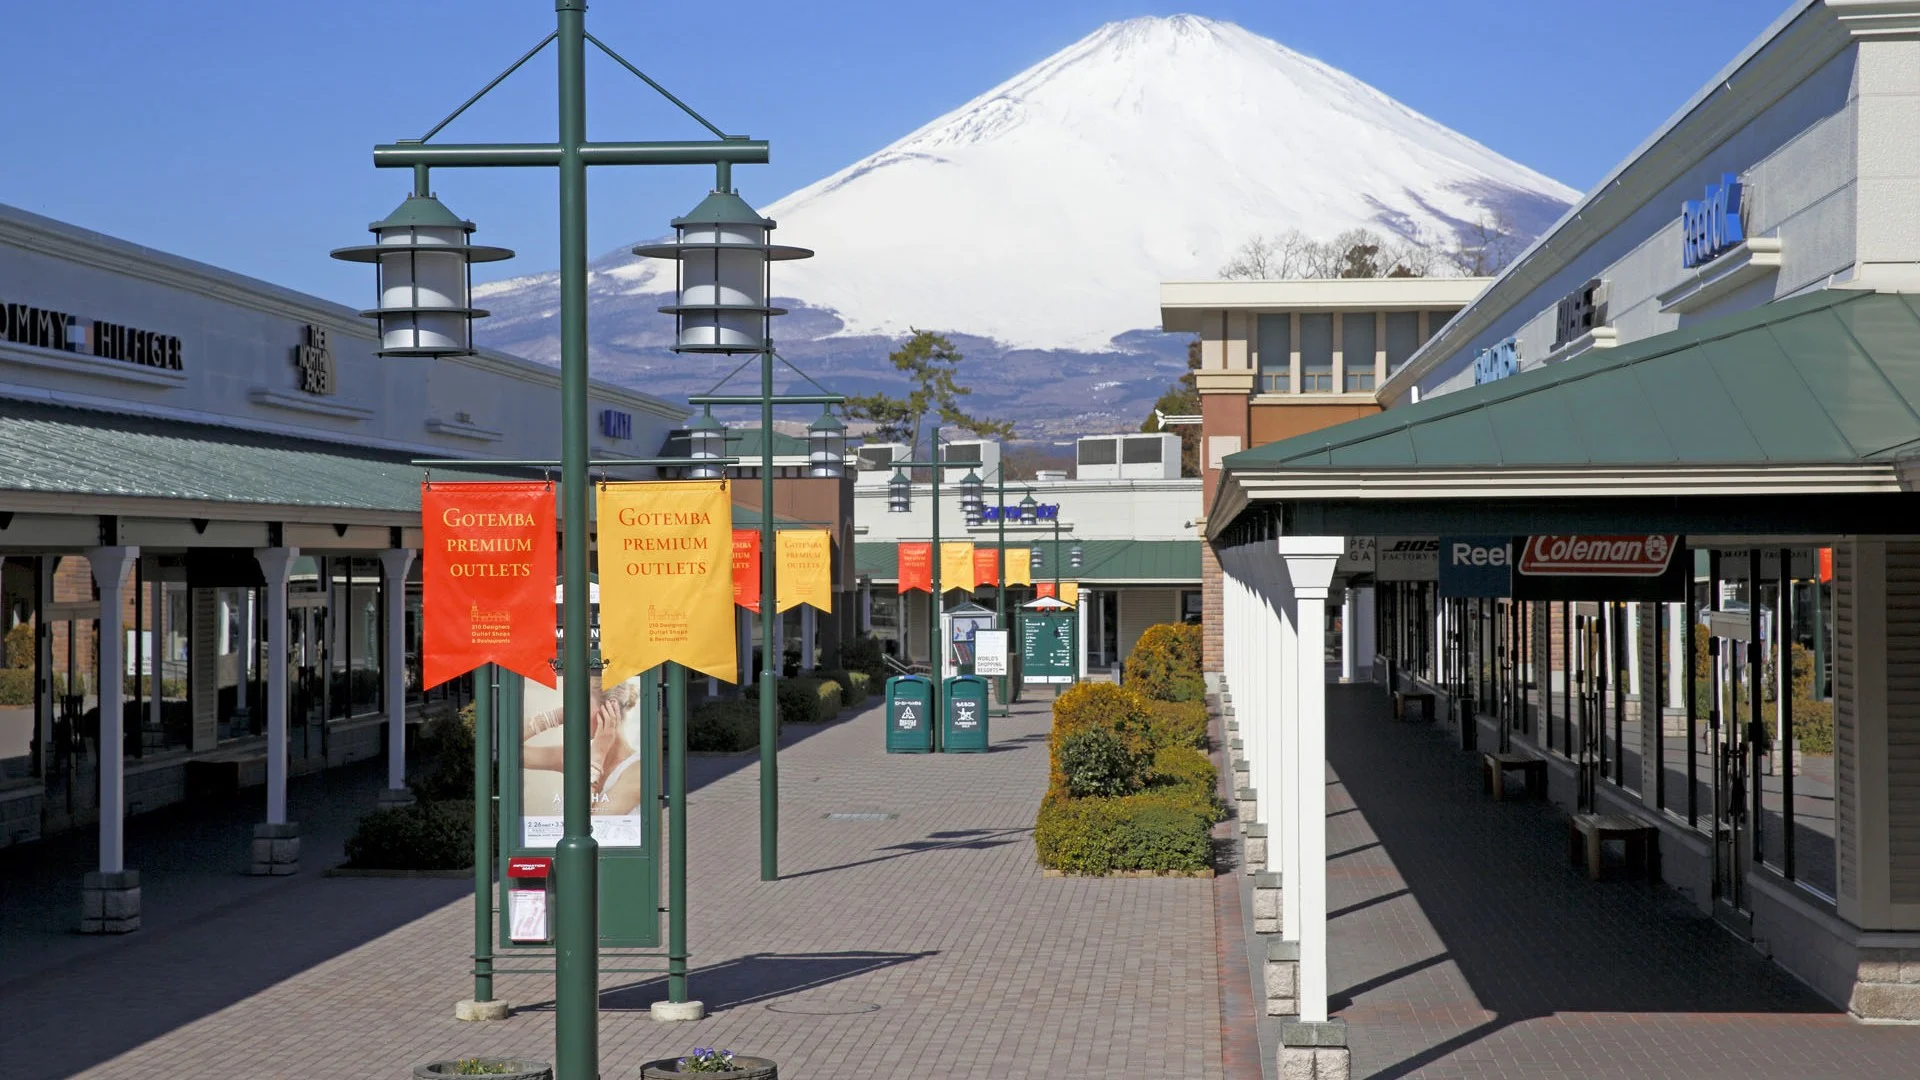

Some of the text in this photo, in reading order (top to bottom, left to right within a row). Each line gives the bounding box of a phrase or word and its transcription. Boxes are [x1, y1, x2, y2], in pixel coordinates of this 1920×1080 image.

[97, 321, 183, 370] HILFIGER
[443, 508, 536, 527] GOTEMBA
[619, 508, 711, 526] GOTEMBA
[447, 539, 532, 552] PREMIUM
[623, 537, 708, 550] PREMIUM
[1534, 536, 1643, 562] Coleman
[1382, 553, 1428, 561] FACTORY
[450, 564, 531, 577] OUTLETS
[626, 562, 707, 576] OUTLETS
